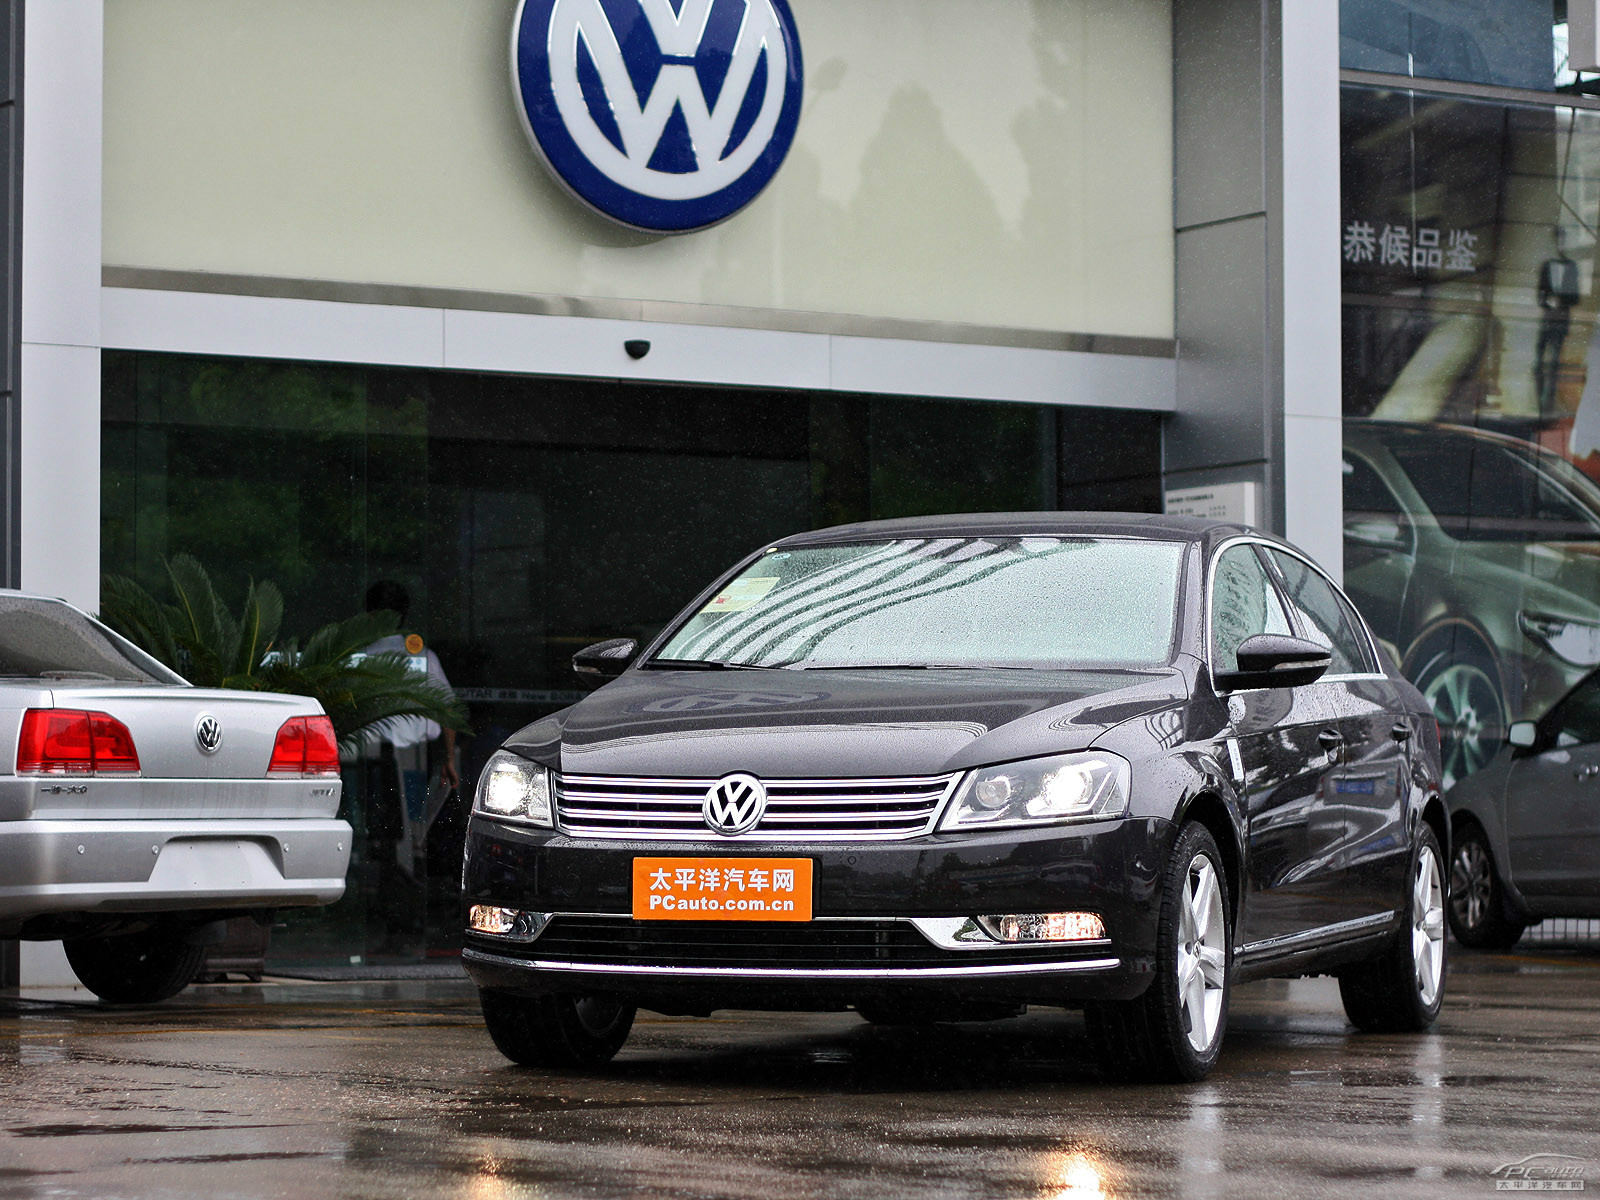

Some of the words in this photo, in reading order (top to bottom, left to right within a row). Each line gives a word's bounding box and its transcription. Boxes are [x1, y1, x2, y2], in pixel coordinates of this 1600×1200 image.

[1343, 220, 1478, 272] 恭候品鉴
[704, 774, 766, 835] VW
[650, 868, 794, 892] 太平洋汽车网
[650, 895, 794, 911] PCauto.com.cn
